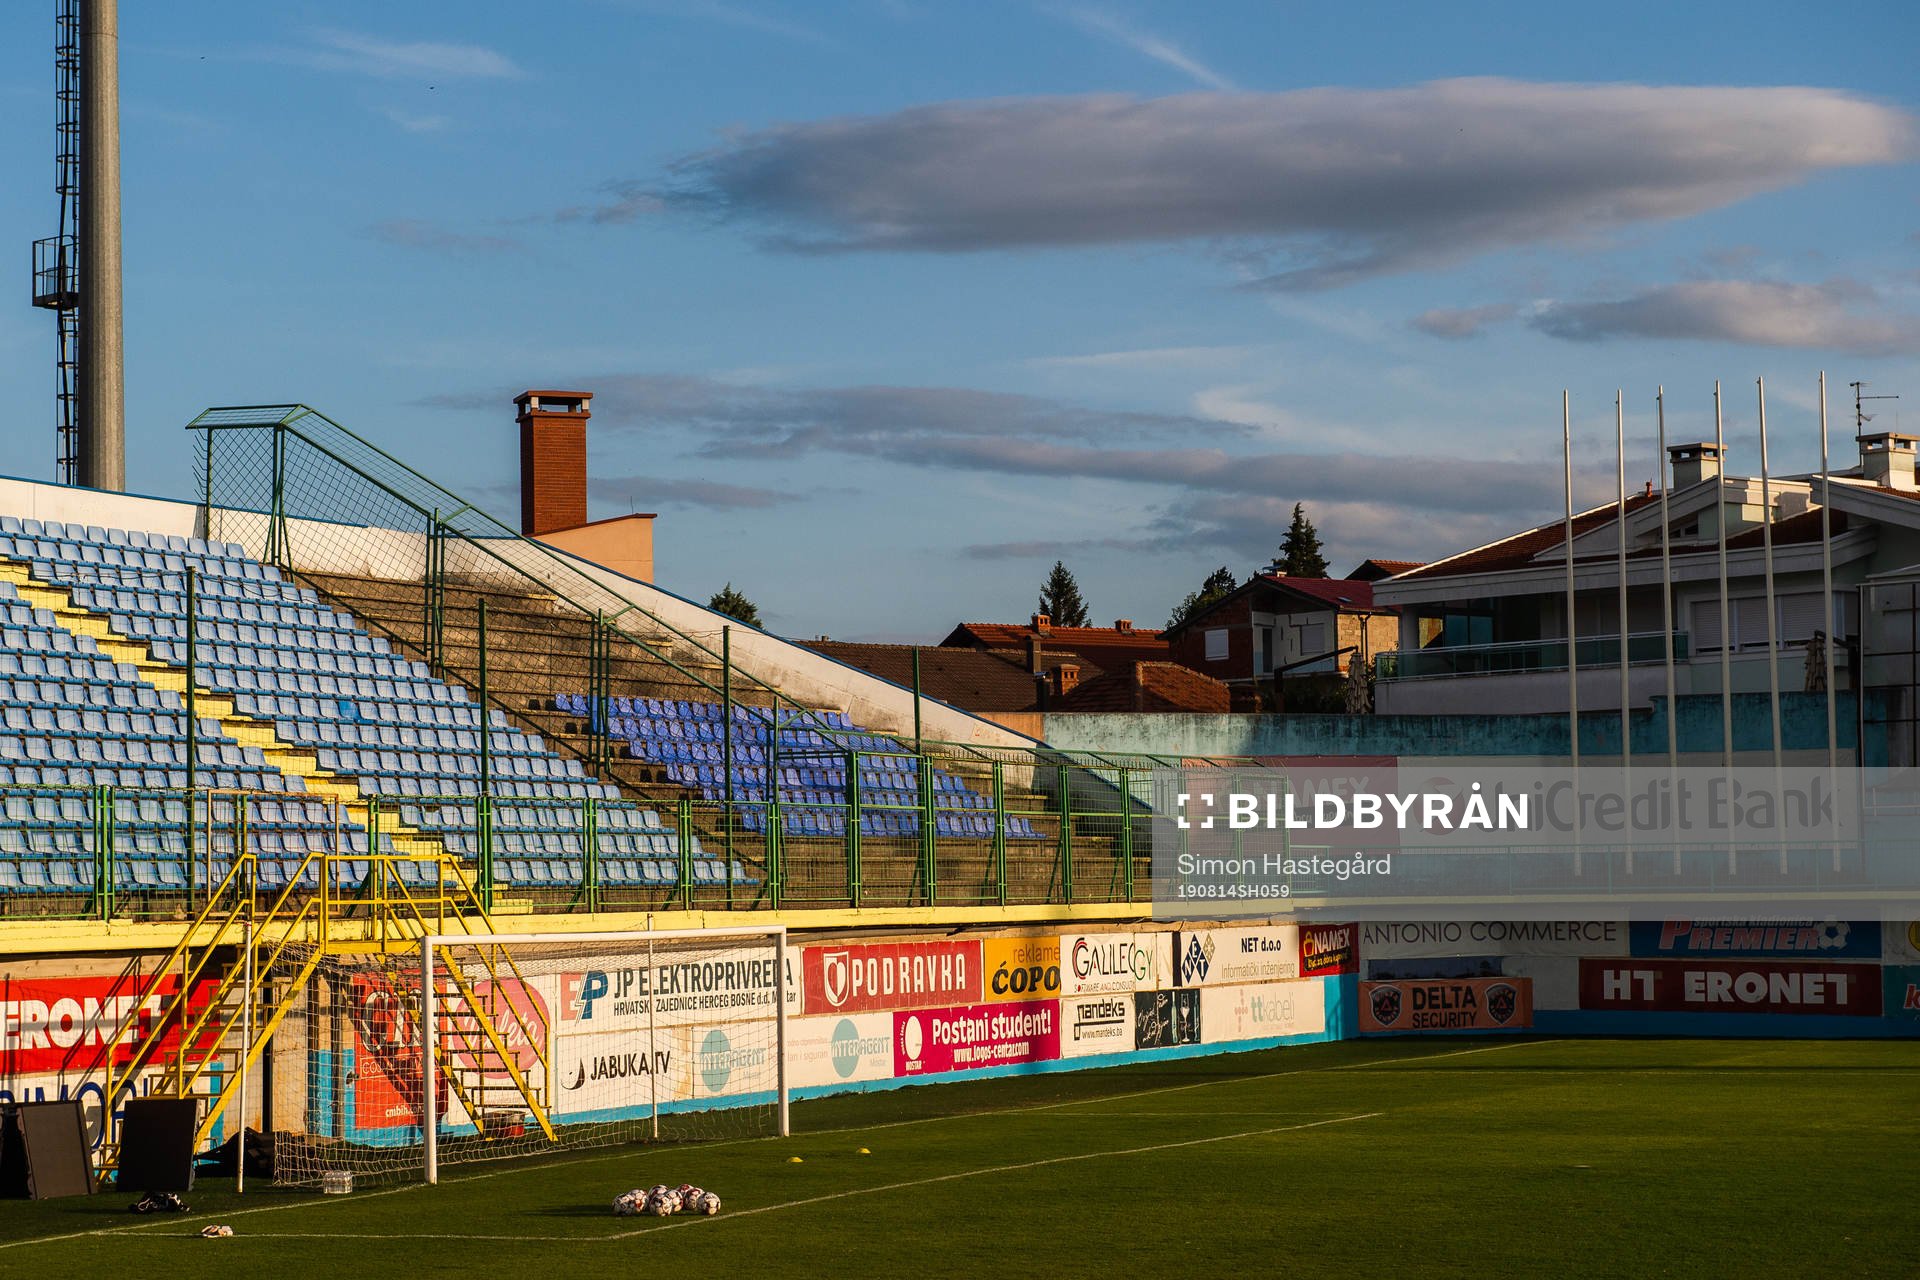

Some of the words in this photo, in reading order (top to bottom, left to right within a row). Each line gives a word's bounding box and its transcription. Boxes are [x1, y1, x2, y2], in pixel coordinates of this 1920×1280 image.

[1708, 776, 1842, 829] Bank
[1241, 937, 1258, 953] NET
[1314, 927, 1350, 953] NAMEX
[1363, 922, 1462, 945] ANTONIO
[1469, 921, 1617, 943] COMMERCE
[1658, 915, 1820, 950] PREMIER
[1013, 943, 1060, 965] reklame
[614, 966, 634, 999] JP
[639, 958, 793, 996] EEKTROPRIVREDA
[852, 953, 966, 997] PODRAVKA
[1684, 971, 1848, 1005] ERONET
[613, 1000, 652, 1017] HRVATSK
[655, 995, 698, 1013] ZAJEDNICE
[699, 994, 729, 1009] HERCEG
[730, 992, 755, 1007] BOSNE
[771, 991, 796, 1004] Mtar
[1412, 986, 1477, 1010] DELTA
[932, 1012, 989, 1046] Postani
[991, 1009, 1052, 1039] student!
[1412, 1011, 1477, 1029] SECURITY
[831, 1036, 890, 1057] INTERAGENT
[954, 1041, 1029, 1063] www.logos-centar.com
[590, 1050, 671, 1081] JABUKA.TV
